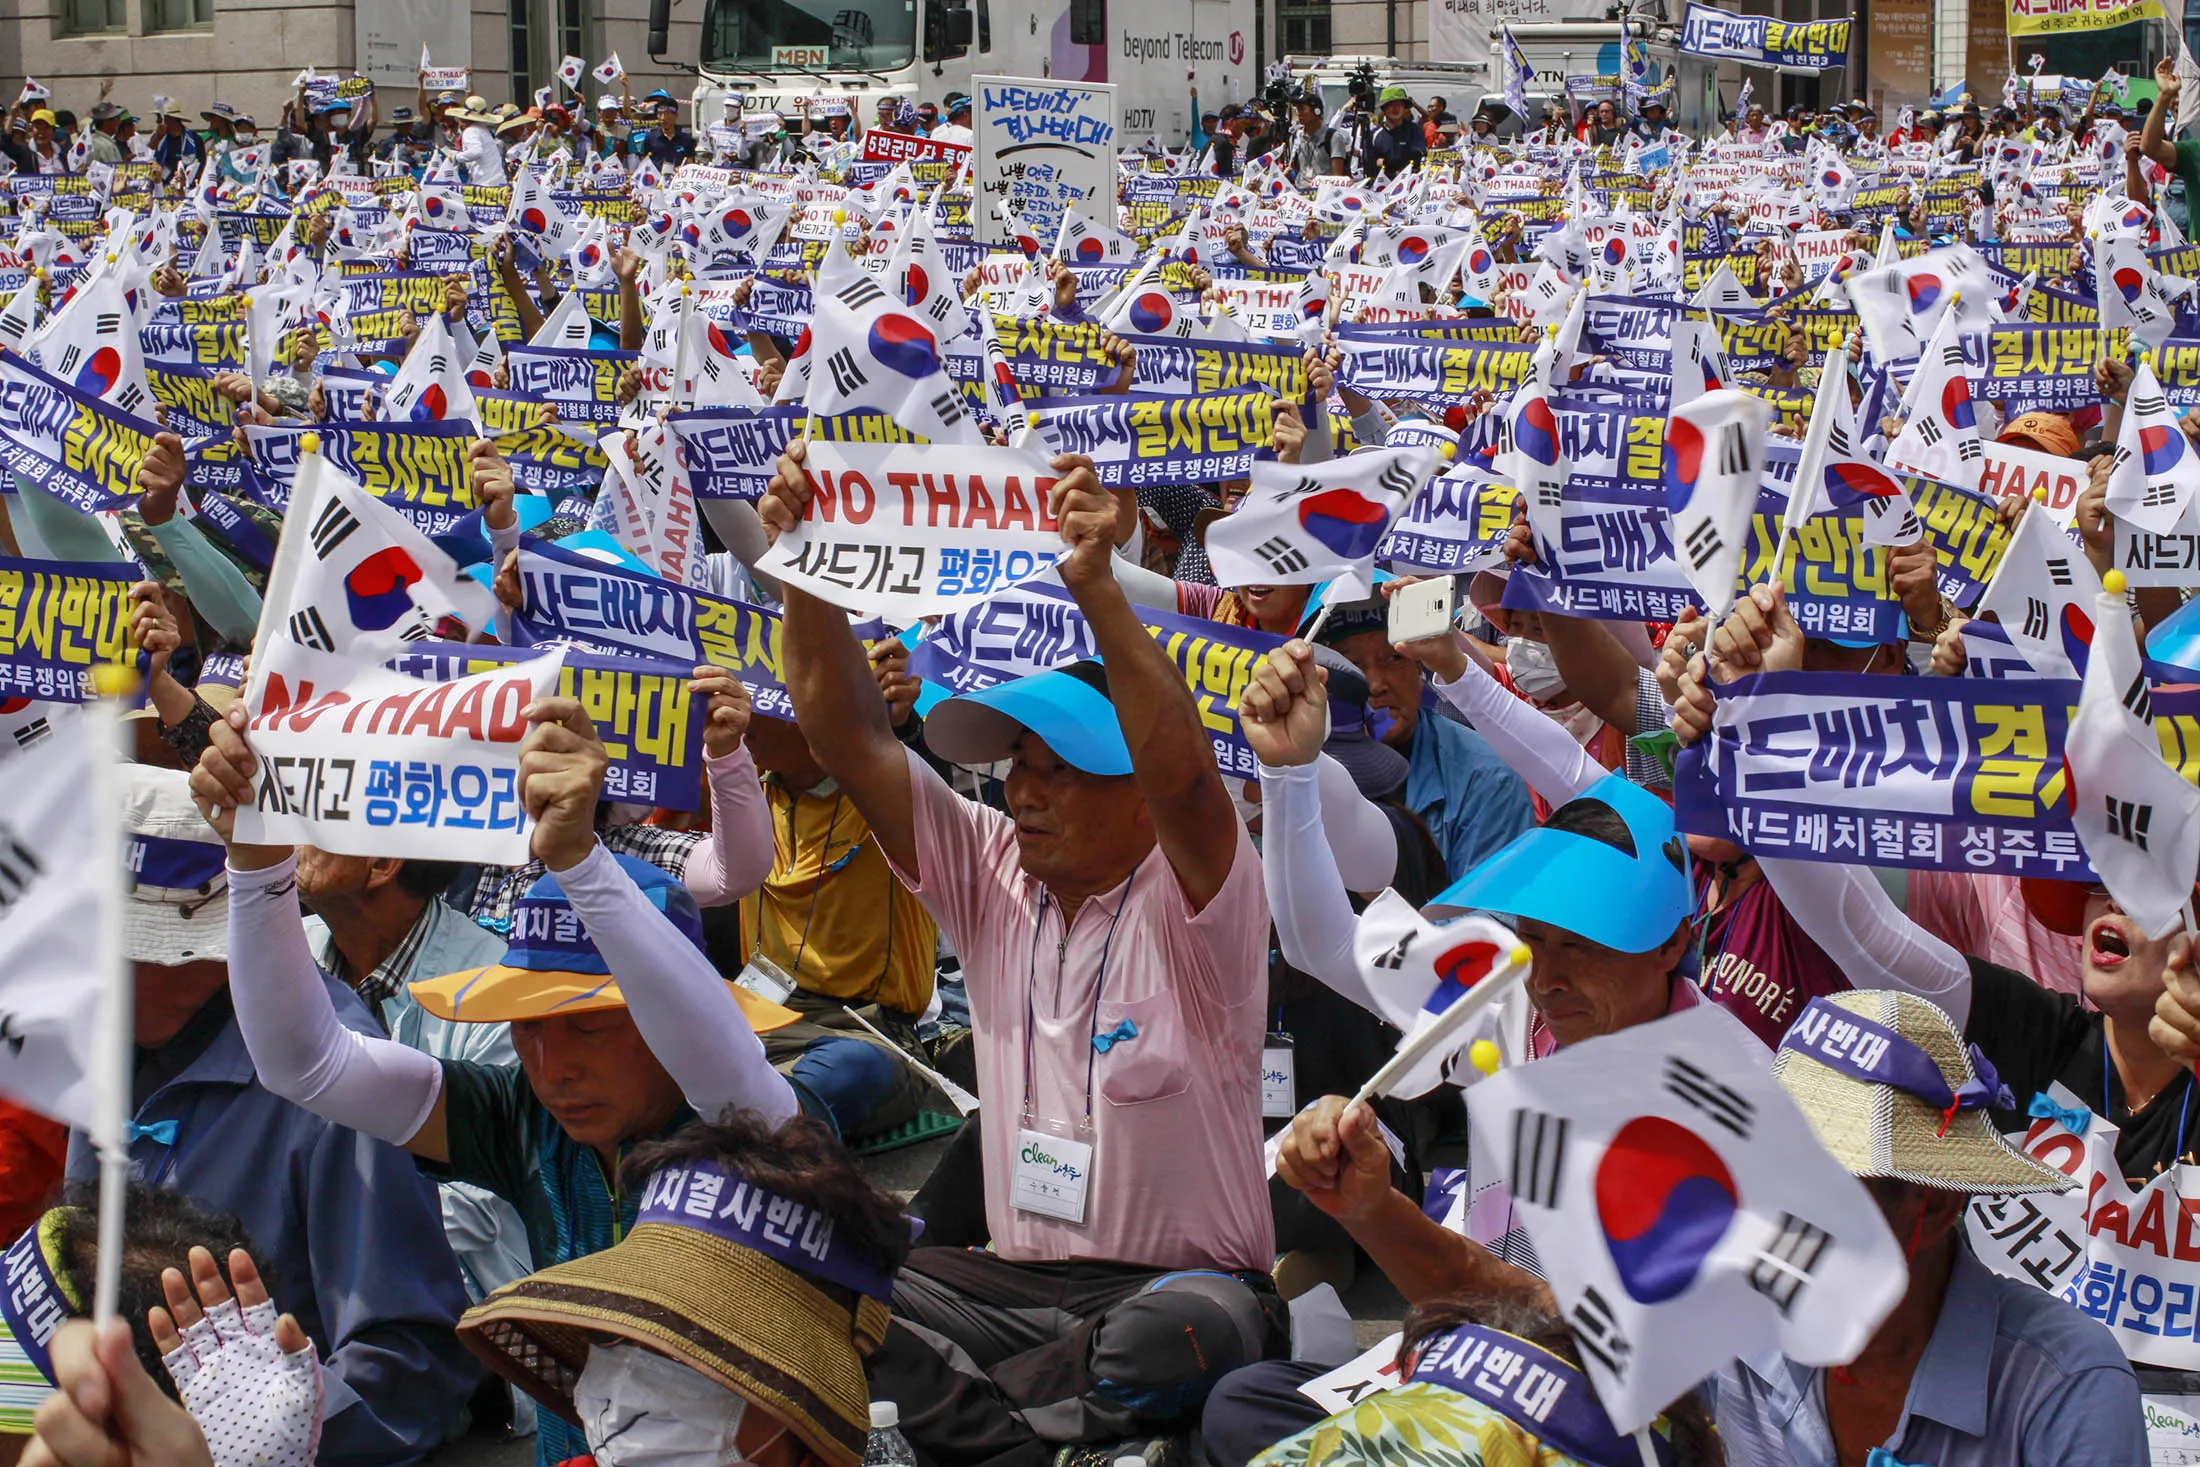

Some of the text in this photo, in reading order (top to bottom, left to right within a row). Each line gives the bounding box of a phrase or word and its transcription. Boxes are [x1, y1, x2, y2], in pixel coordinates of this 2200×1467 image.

[776, 49, 825, 65] MBN
[1123, 28, 1224, 64] beyond Telecom
[1683, 19, 1763, 51] 사드배치
[1765, 21, 1849, 55] 결사반대
[1533, 70, 1564, 83] YTN
[1124, 109, 1156, 128] HDTV
[867, 135, 918, 160] 5만군민
[1734, 149, 1763, 160] THAAD
[689, 168, 728, 183] THAAD
[796, 190, 815, 202] NO
[1750, 203, 1772, 218] NO
[1797, 235, 1850, 259] THAAD
[510, 354, 593, 394] 사드배치
[685, 419, 793, 476] 사드배치
[1130, 396, 1276, 459] 결사반대
[805, 469, 1062, 532] NO THAAD
[783, 541, 925, 595] 사드가고
[522, 571, 687, 642] 사드배치
[250, 670, 532, 744] NO THAAD
[1718, 700, 2066, 819] 드배치 결
[259, 755, 525, 836] 사드가고 평화오라
[1727, 807, 2098, 873] 사드배치철회 성주투
[1791, 1006, 1892, 1073] 사반대
[1417, 1332, 1568, 1423] 결사반대
